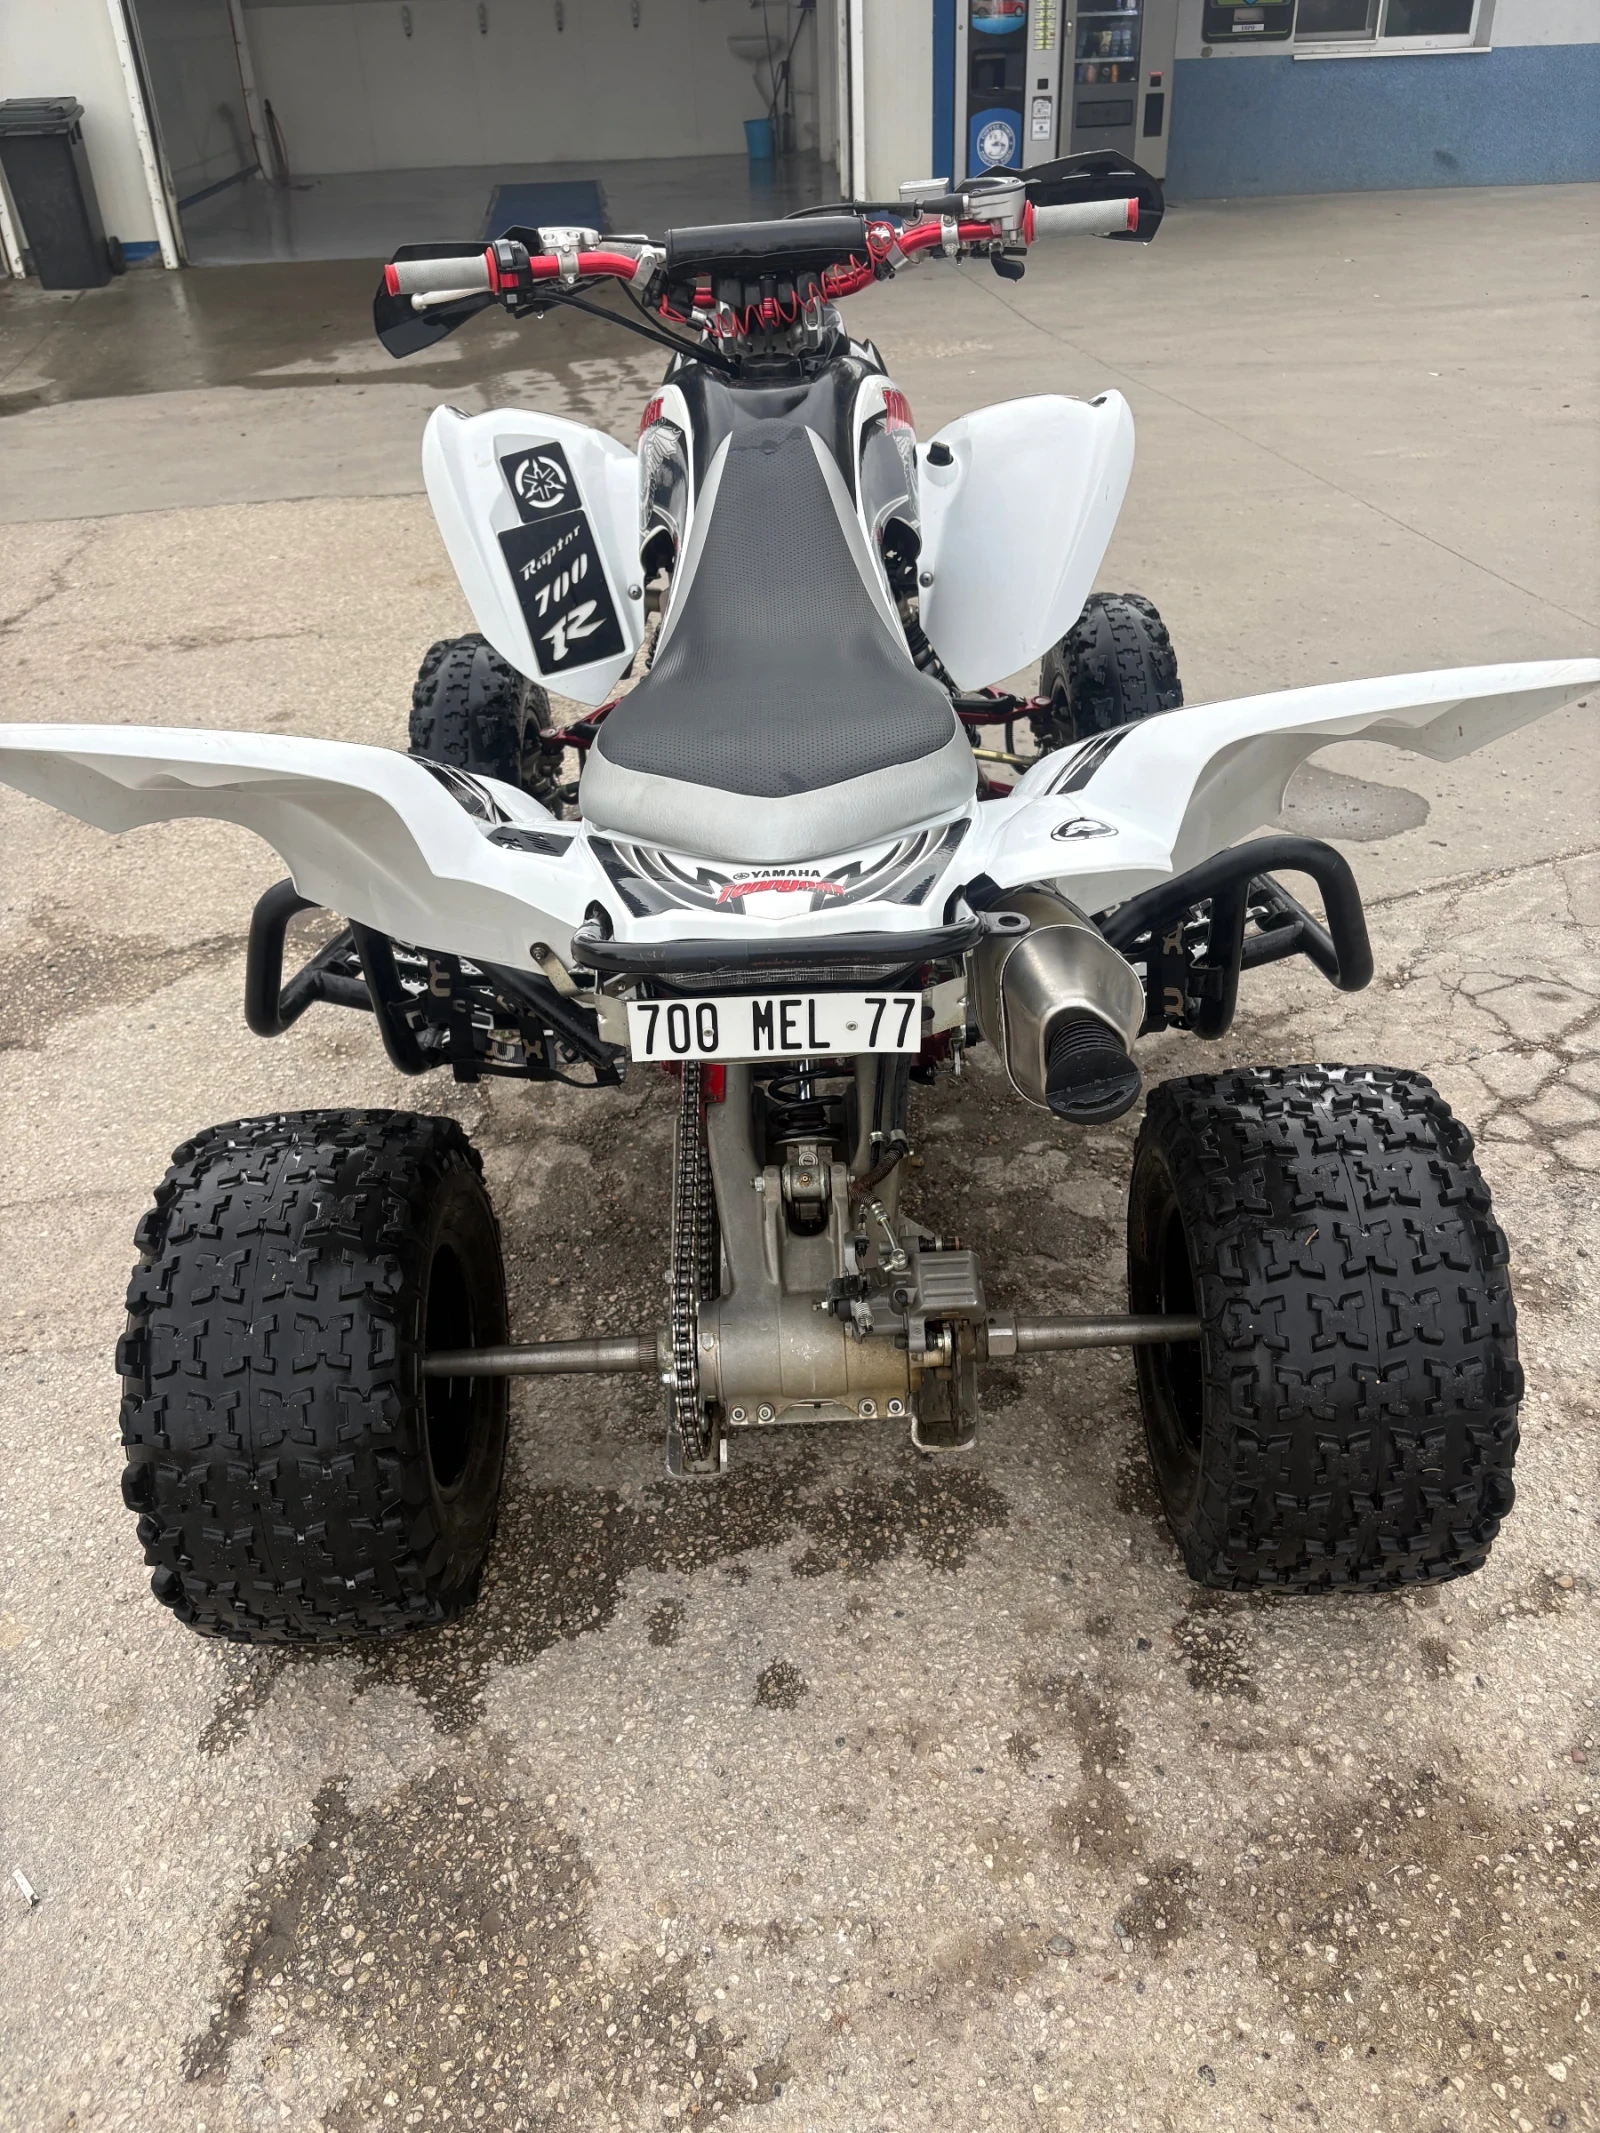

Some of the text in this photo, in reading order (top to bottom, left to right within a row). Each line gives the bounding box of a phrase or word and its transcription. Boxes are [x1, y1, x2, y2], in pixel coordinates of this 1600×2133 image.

[519, 525, 580, 581] Raptor
[535, 553, 588, 617] 700
[540, 600, 608, 661] R
[751, 870, 821, 878] YAMAHA
[637, 998, 916, 1055] 700 MEL 77
